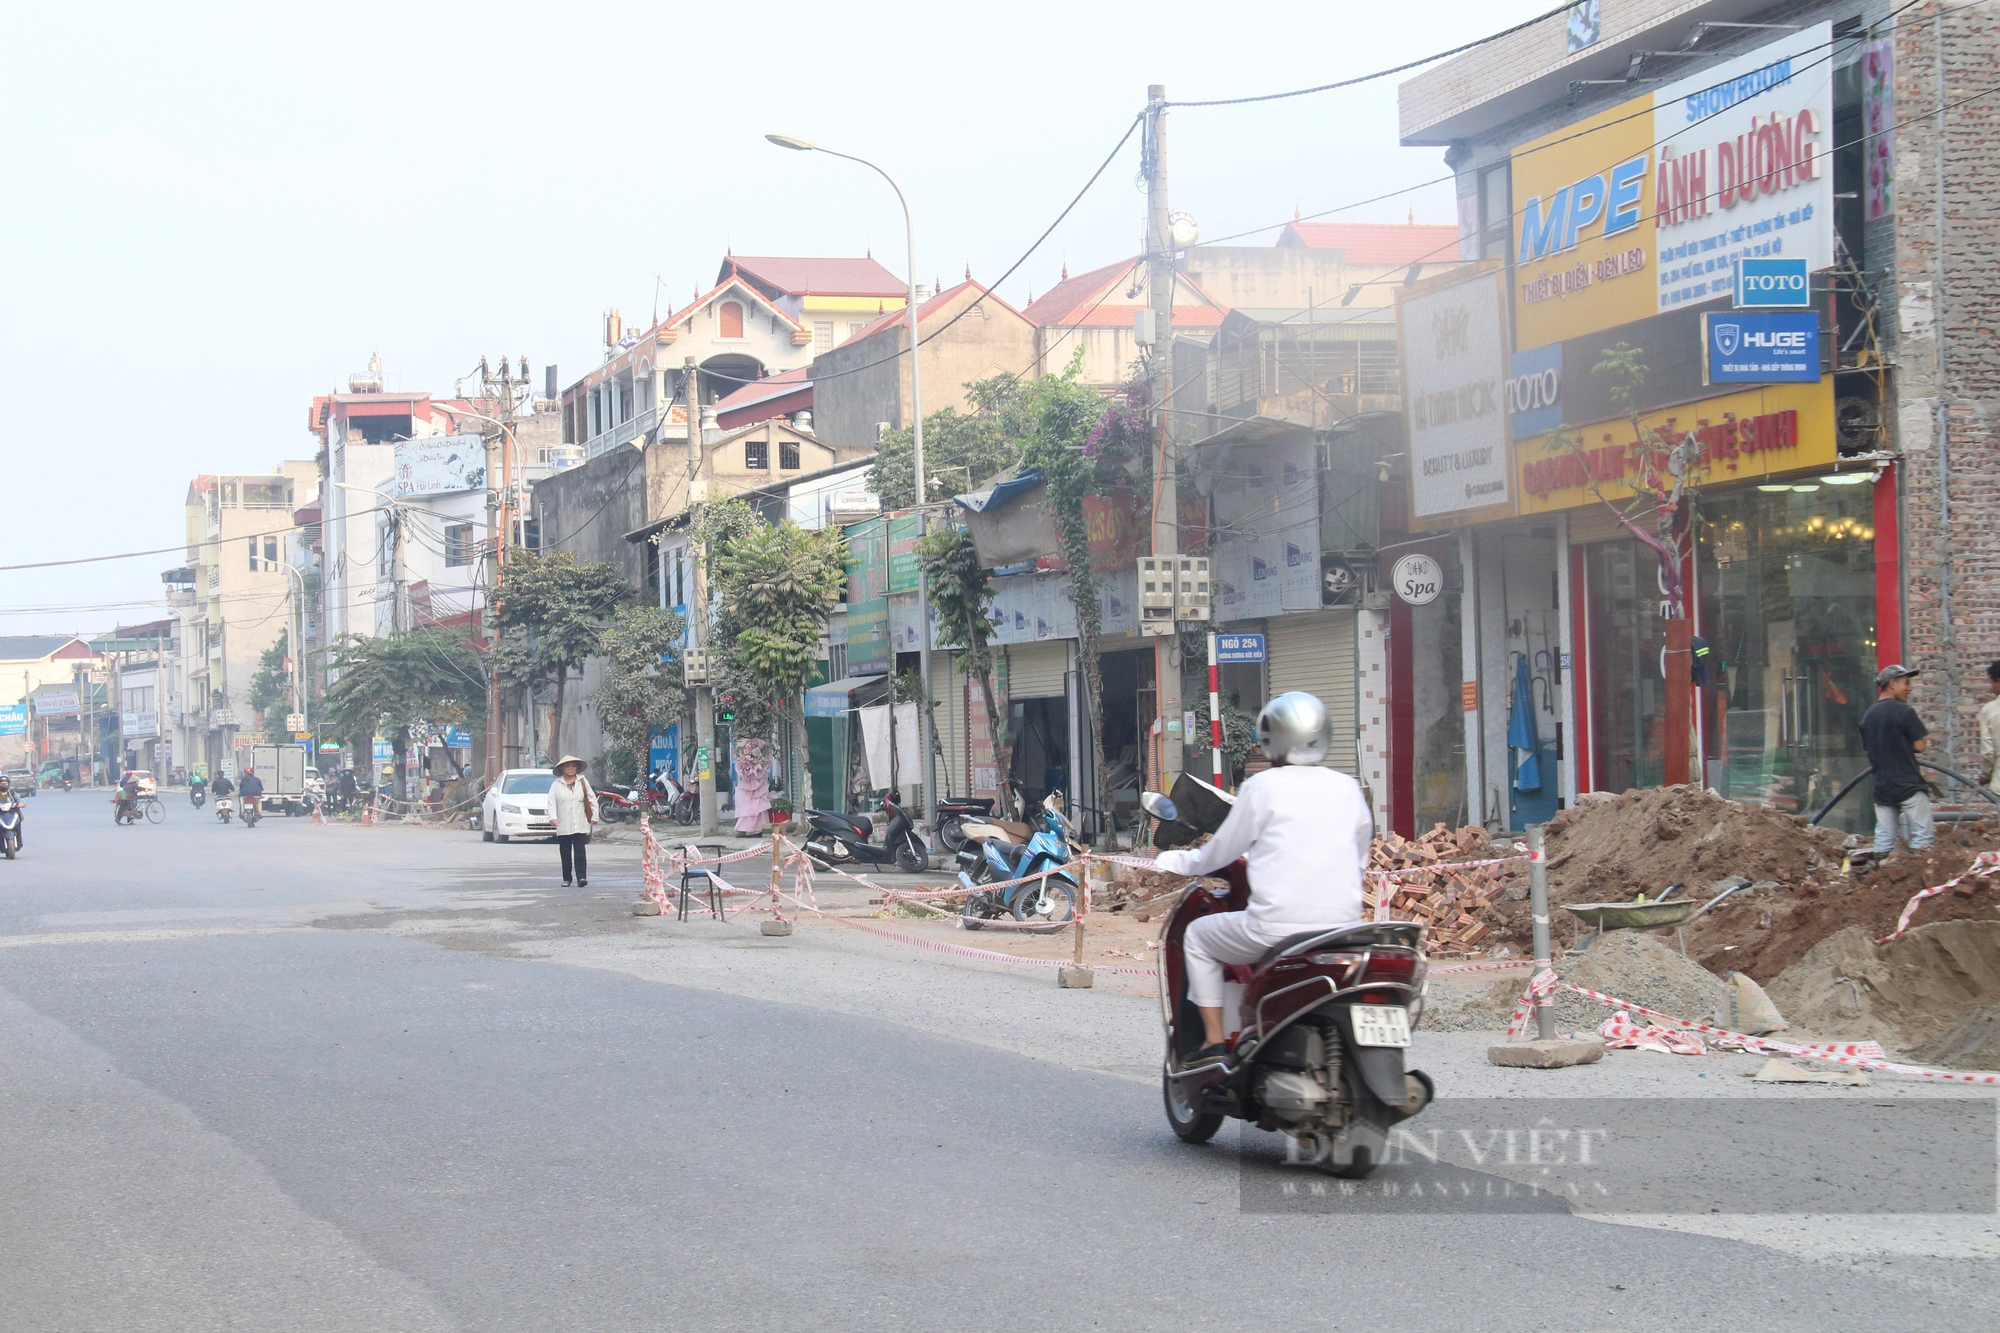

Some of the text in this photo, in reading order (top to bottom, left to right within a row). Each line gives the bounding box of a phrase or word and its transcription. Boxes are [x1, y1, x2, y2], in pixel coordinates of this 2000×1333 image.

[1686, 55, 1792, 122] SHOWROOM
[1655, 109, 1820, 229] ÁNH DƯƠNG
[1517, 154, 1649, 266] MPE
[1522, 270, 1551, 304] THIẾT
[1551, 273, 1567, 299] BỊ
[1565, 261, 1592, 293] ĐIỆN
[1597, 252, 1619, 281] ĐÈN
[1621, 247, 1646, 275] LED
[1745, 275, 1804, 290] TOTO
[1744, 332, 1806, 347] HUGE
[1506, 368, 1558, 414] TOTO
[1739, 408, 1797, 454] SINH
[1423, 453, 1453, 477] BEAUTY
[398, 481, 414, 493] SPA
[1289, 552, 1312, 566] LION KING
[1267, 566, 1277, 577] KING
[1404, 580, 1436, 598] Spa
[1222, 637, 1257, 649] NGÕ 254
[0, 712, 24, 722] CHÂU
